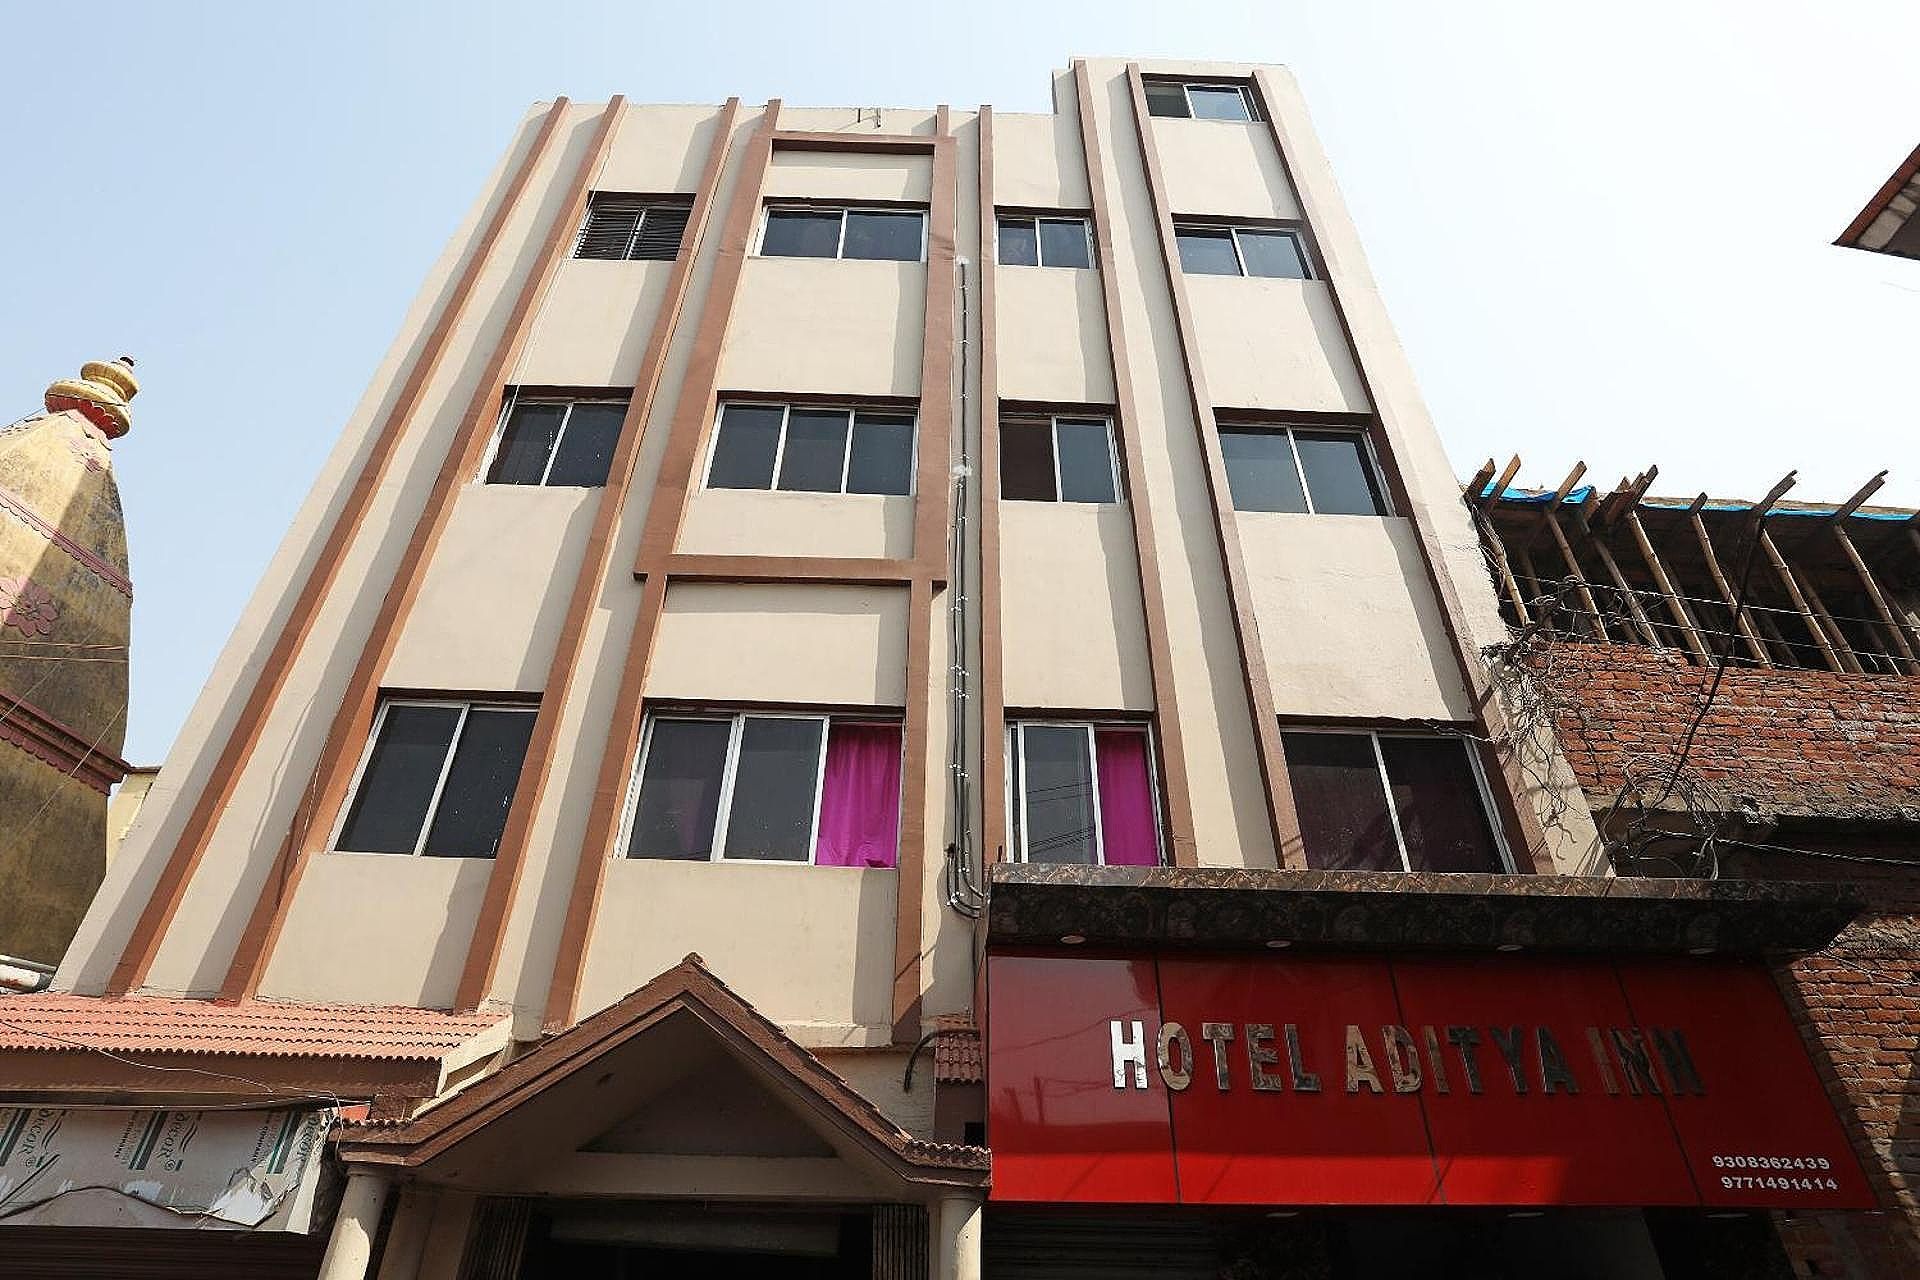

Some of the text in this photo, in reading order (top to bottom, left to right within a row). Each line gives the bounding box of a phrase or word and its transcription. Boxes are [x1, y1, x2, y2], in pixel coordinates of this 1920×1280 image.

[1110, 1020, 1704, 1095] HOTEL ADITYA INN
[1712, 1156, 1830, 1169] 9308362439
[1721, 1176, 1838, 1190] 9771491414
